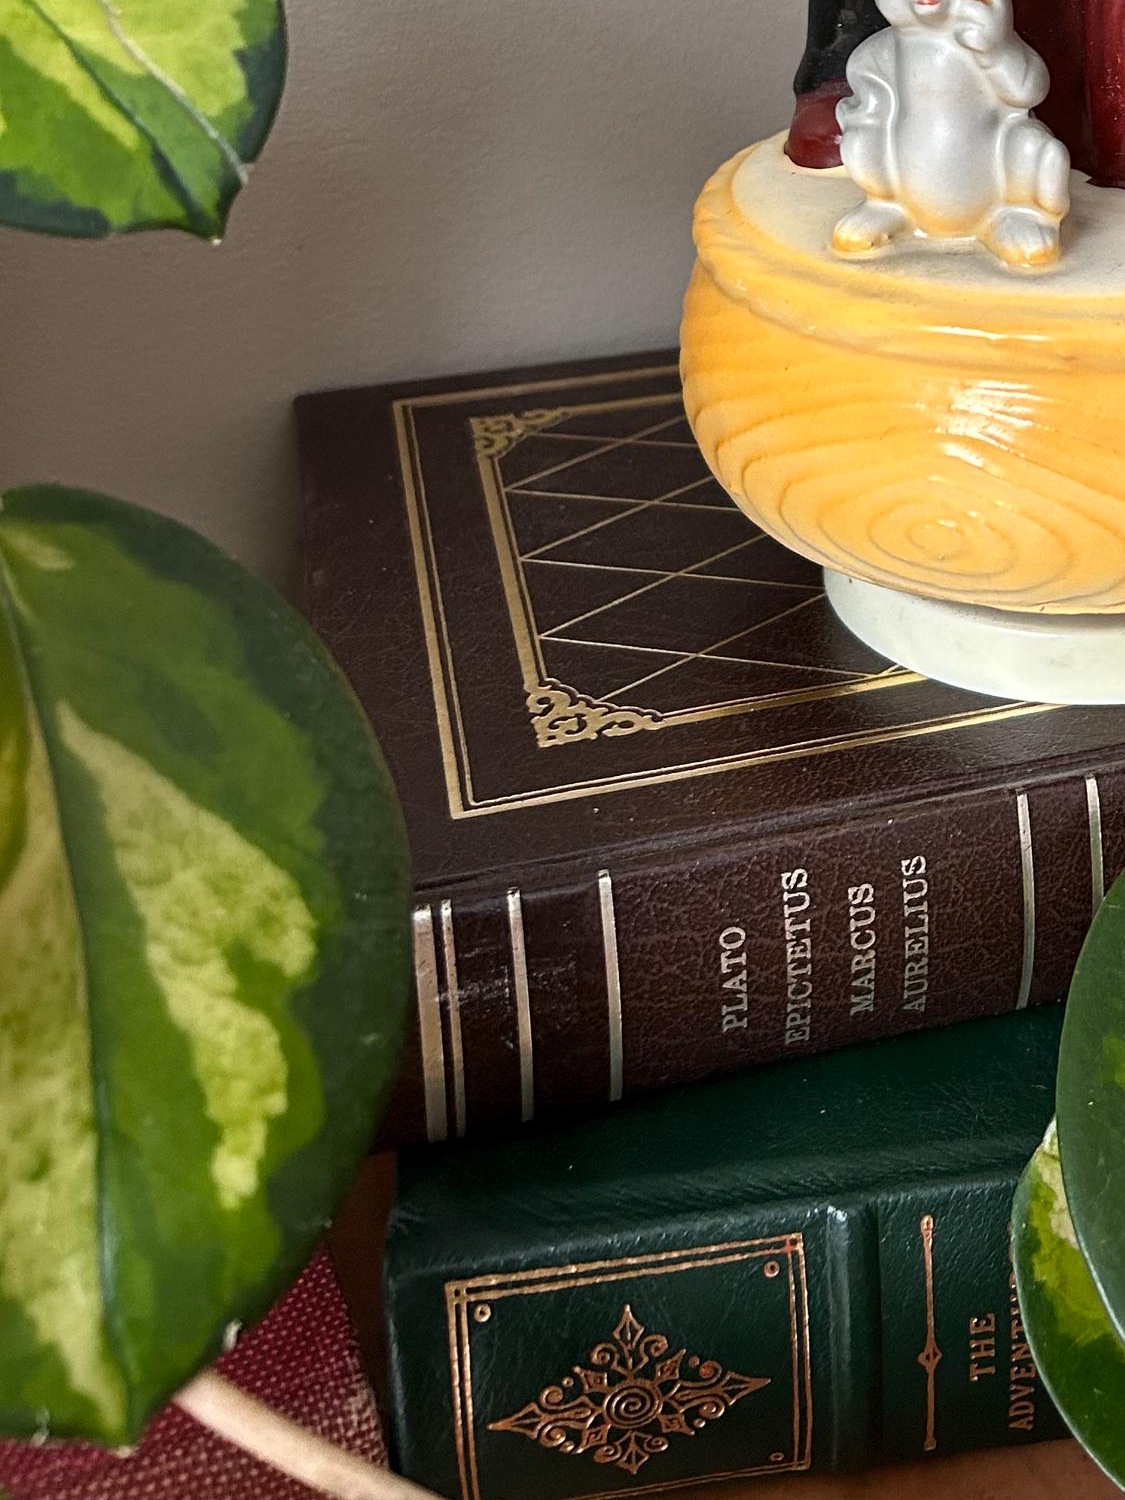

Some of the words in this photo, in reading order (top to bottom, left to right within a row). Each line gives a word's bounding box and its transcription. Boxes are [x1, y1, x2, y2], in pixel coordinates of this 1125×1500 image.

[719, 926, 748, 1033] PLATO
[781, 868, 812, 1045] EPICTETUS
[848, 883, 876, 1016] MARCUS
[901, 855, 930, 1012] AURELIUS
[969, 1312, 995, 1382] THE
